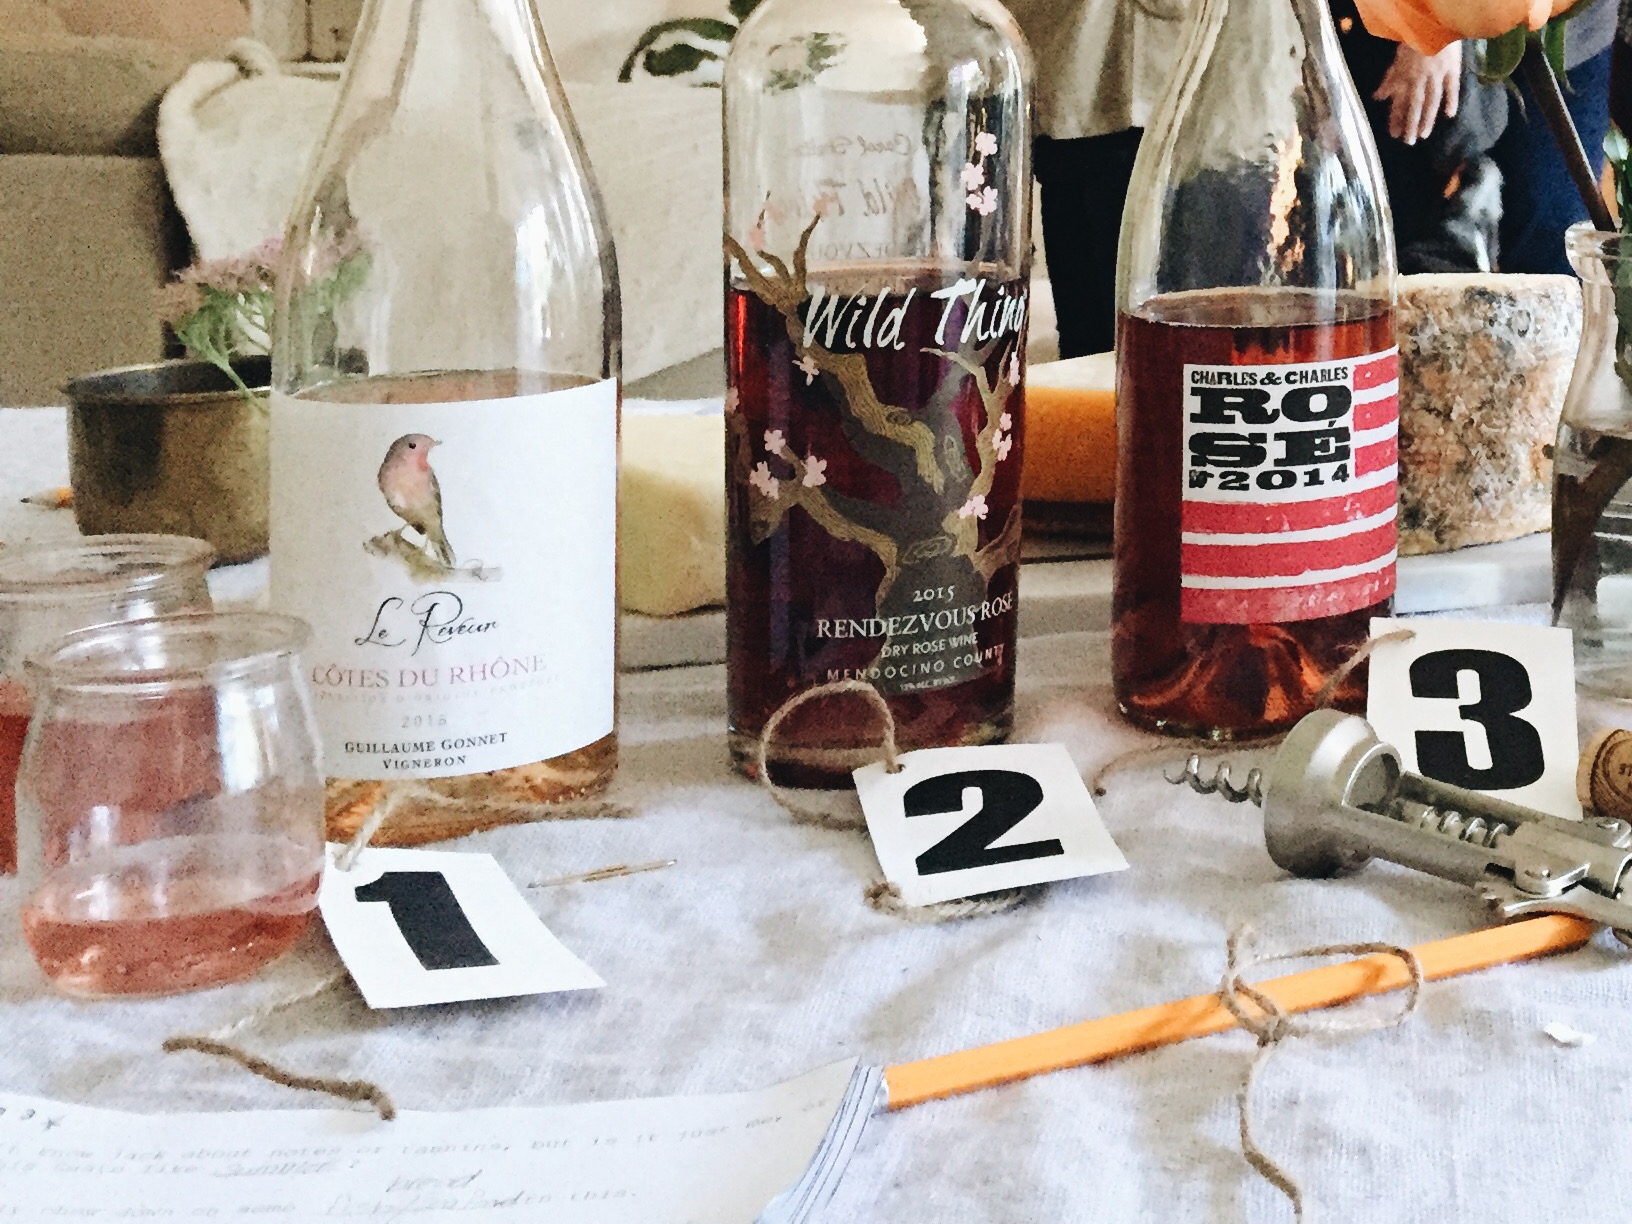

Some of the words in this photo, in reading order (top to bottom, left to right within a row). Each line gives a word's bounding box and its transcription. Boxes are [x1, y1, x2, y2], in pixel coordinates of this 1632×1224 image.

[802, 282, 917, 351] Wild
[1190, 370, 1258, 386] CHARLES
[1259, 371, 1283, 386] &
[1284, 366, 1349, 385] CHARLES
[1189, 385, 1352, 425] RO
[1188, 420, 1352, 469] SÉ
[1218, 463, 1350, 491] 2014
[912, 584, 956, 603] 2015
[354, 596, 407, 648] Le
[816, 605, 976, 639] RENDEZVOUS
[881, 644, 910, 658] DRY
[948, 632, 979, 649] WINE
[312, 662, 390, 688] CÔTES
[399, 668, 439, 688] DU
[449, 654, 548, 686] RHÔNE
[826, 660, 946, 681] MENDOCINO
[1408, 647, 1546, 792] 3
[344, 740, 435, 754] GUILLAUME
[440, 732, 508, 751] GONNET
[382, 754, 468, 771] VIGNERON
[902, 768, 1065, 876] 2
[354, 870, 501, 971] 1
